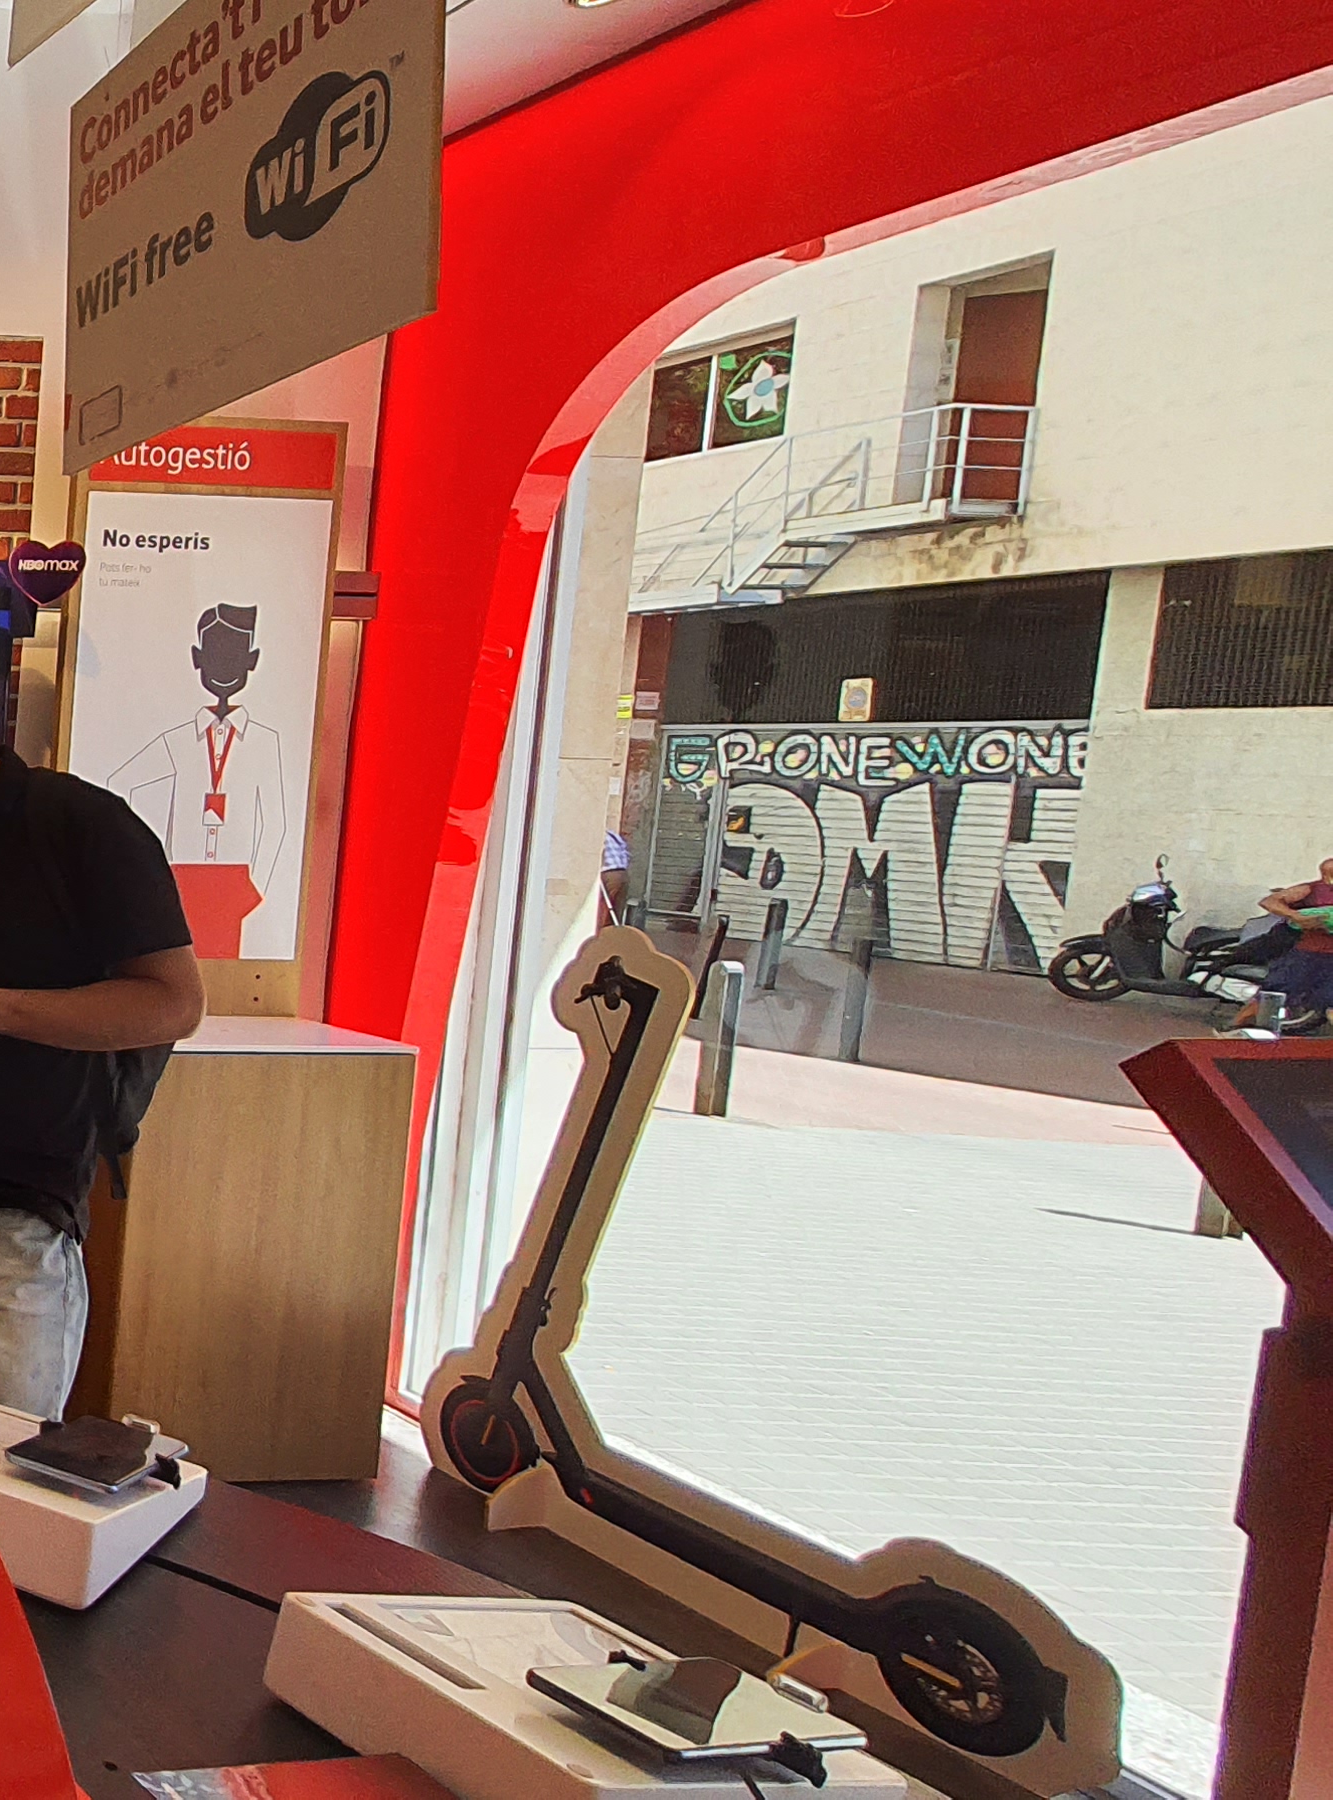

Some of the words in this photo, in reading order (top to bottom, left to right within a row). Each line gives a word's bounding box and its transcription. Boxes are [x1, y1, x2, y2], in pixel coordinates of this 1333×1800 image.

[79, 103, 194, 219] demana
[200, 57, 232, 124] el
[238, 13, 303, 96] teu
[76, 247, 138, 328] WiFi
[145, 211, 215, 285] free
[100, 441, 251, 475] utogestió
[103, 529, 130, 548] No
[135, 532, 210, 553] esperis
